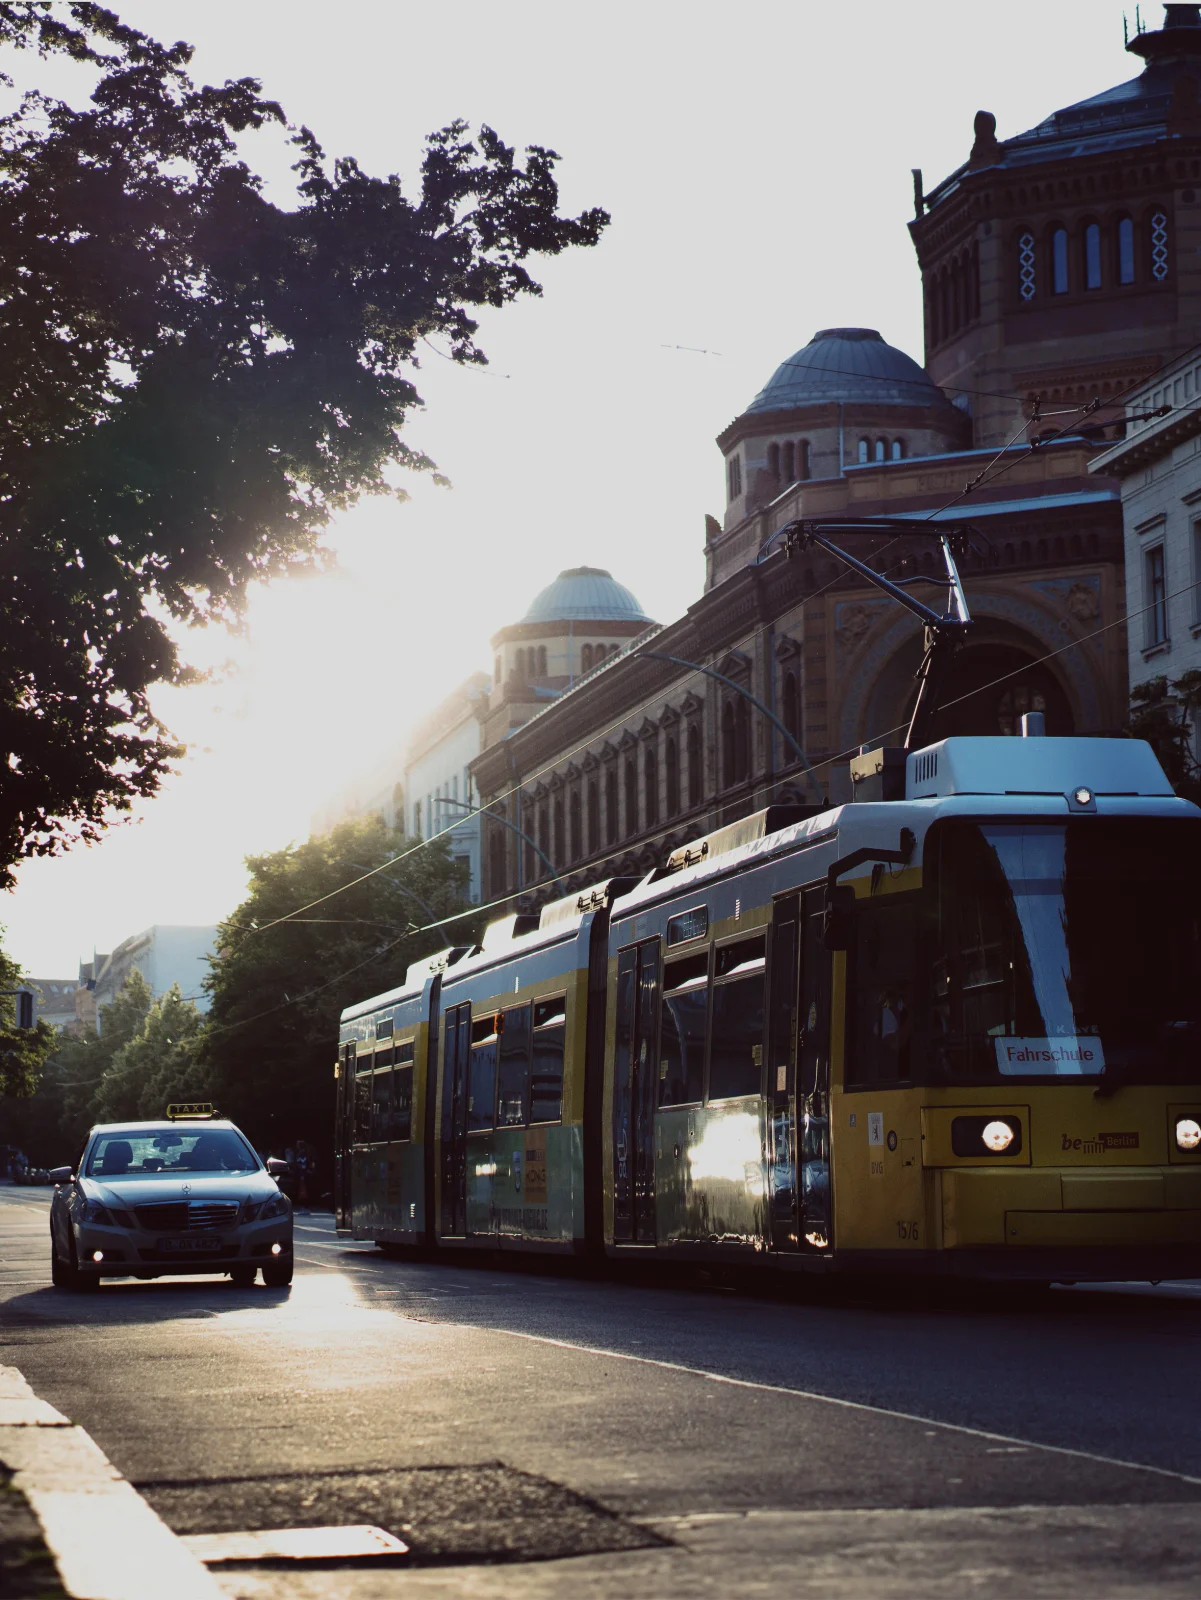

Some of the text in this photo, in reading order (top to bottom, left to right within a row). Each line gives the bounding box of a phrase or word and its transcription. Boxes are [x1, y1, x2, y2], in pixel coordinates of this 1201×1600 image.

[1006, 1046, 1094, 1062] Fahrschule
[175, 1104, 205, 1113] TAXI
[1106, 1135, 1136, 1146] Berlin
[871, 1161, 884, 1175] BVG
[896, 1220, 919, 1241] 1576
